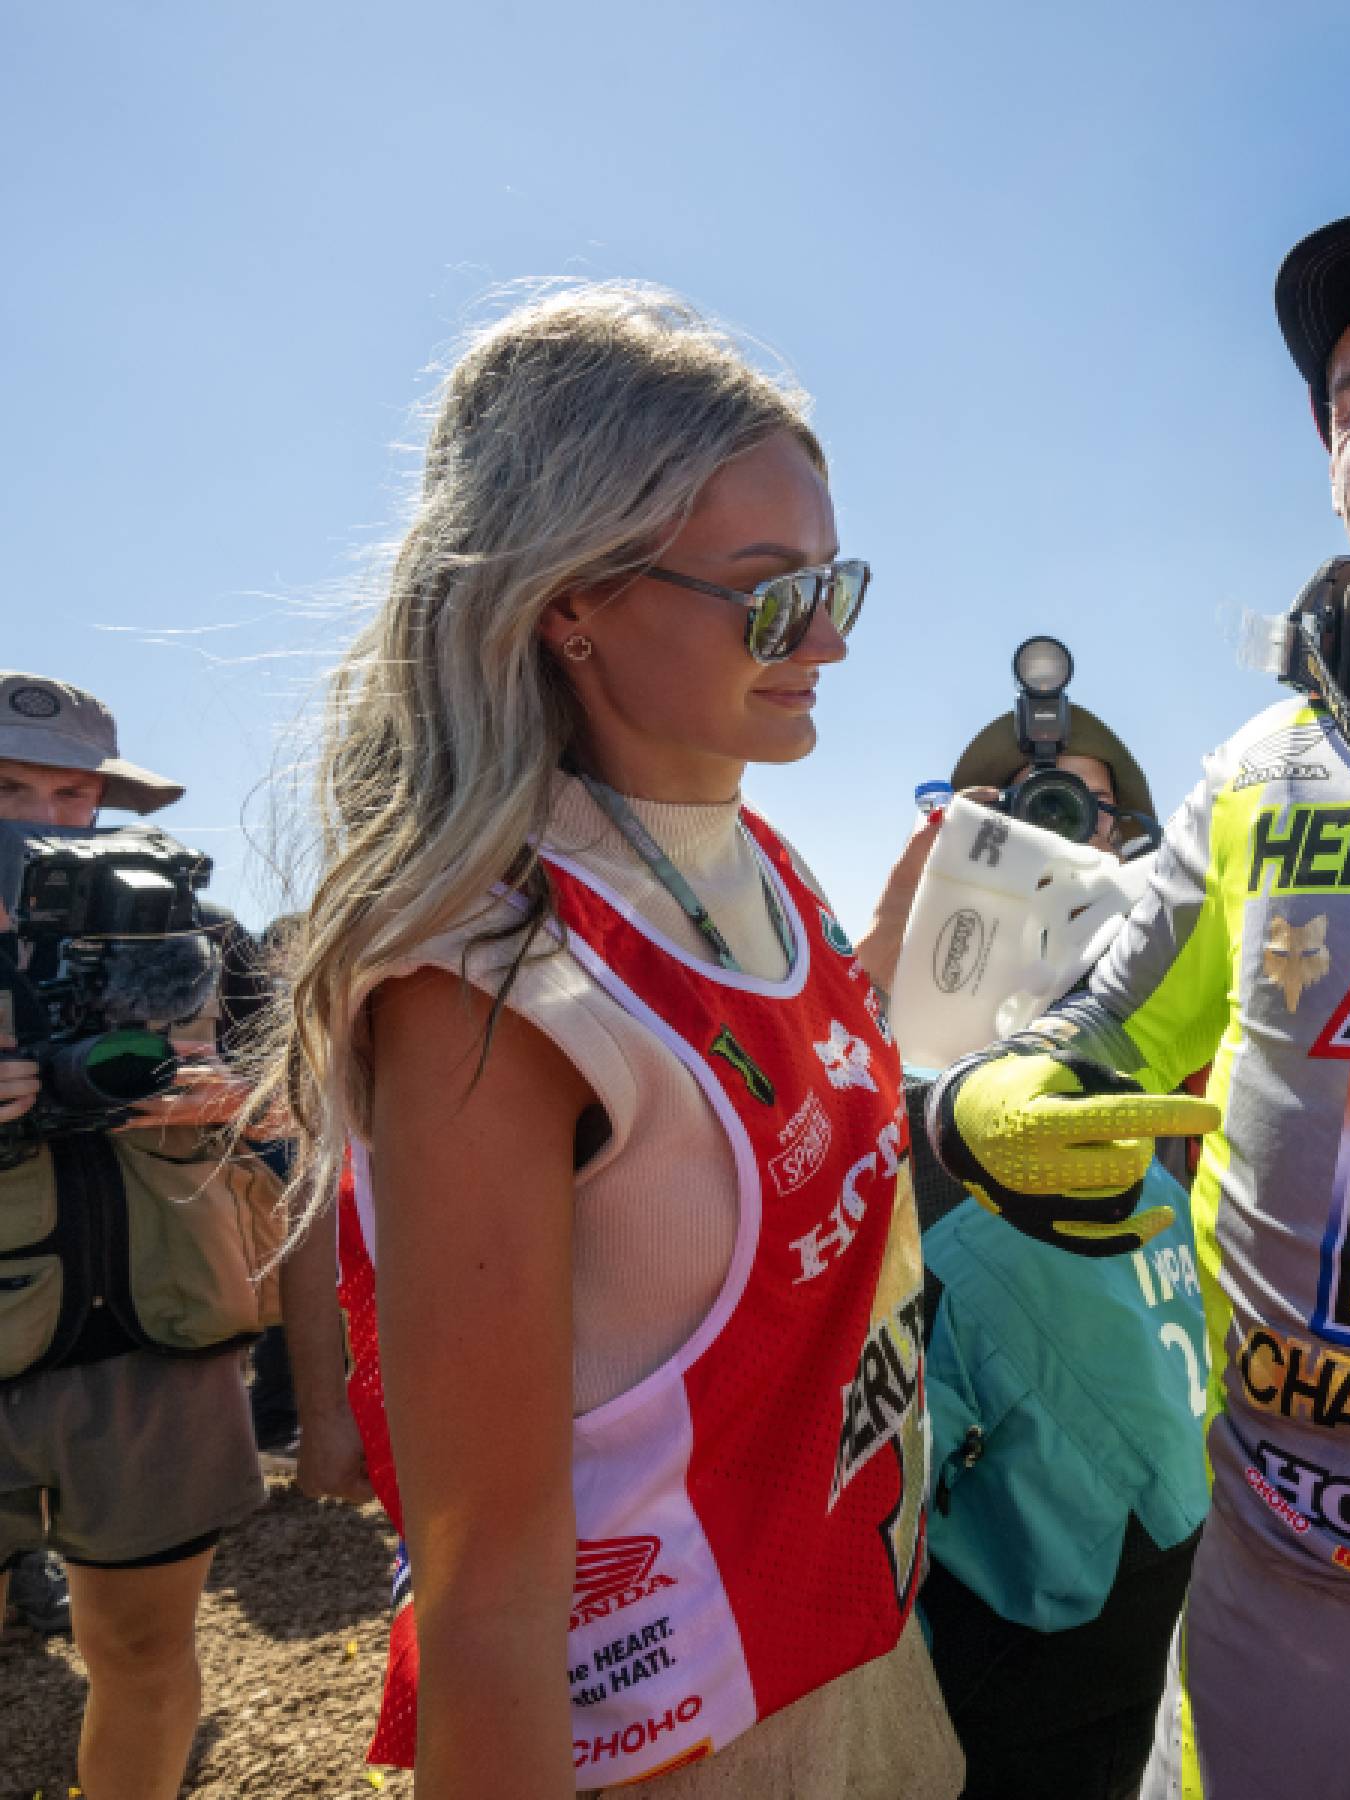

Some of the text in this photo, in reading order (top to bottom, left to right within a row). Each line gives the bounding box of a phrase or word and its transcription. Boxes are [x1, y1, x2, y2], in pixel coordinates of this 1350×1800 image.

[1245, 1468, 1311, 1533] CHOHO
[592, 1615, 675, 1672] HEART.
[608, 1646, 677, 1693] HATI.
[572, 1694, 703, 1770] CHOHO
